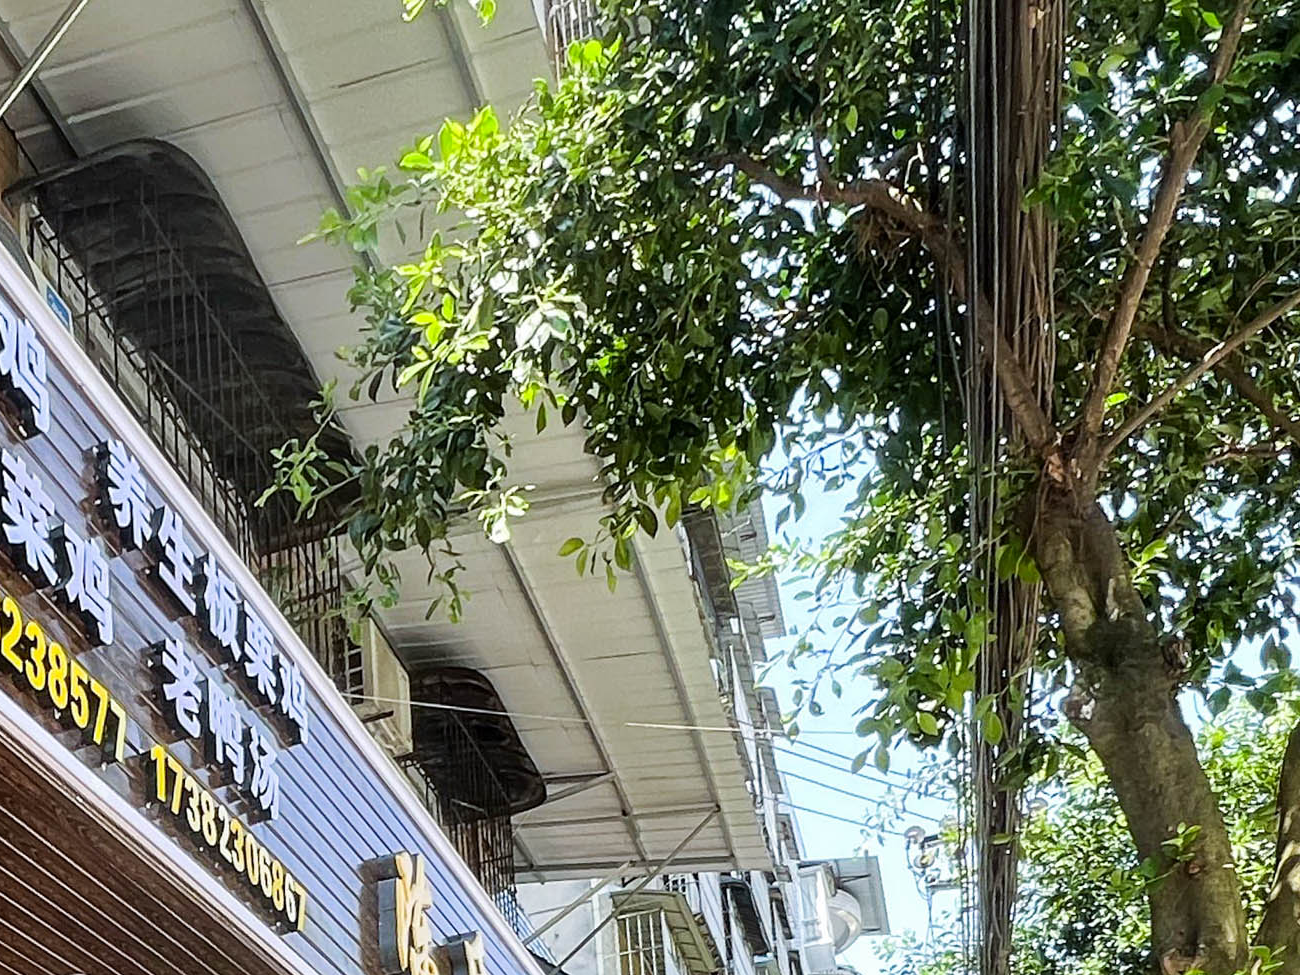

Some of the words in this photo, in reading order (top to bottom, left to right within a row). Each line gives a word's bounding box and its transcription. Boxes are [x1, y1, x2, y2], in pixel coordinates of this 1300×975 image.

[107, 439, 309, 744] 养生板栗鸡
[162, 638, 279, 820] 老鸭汤
[150, 743, 307, 932] 17382306867
